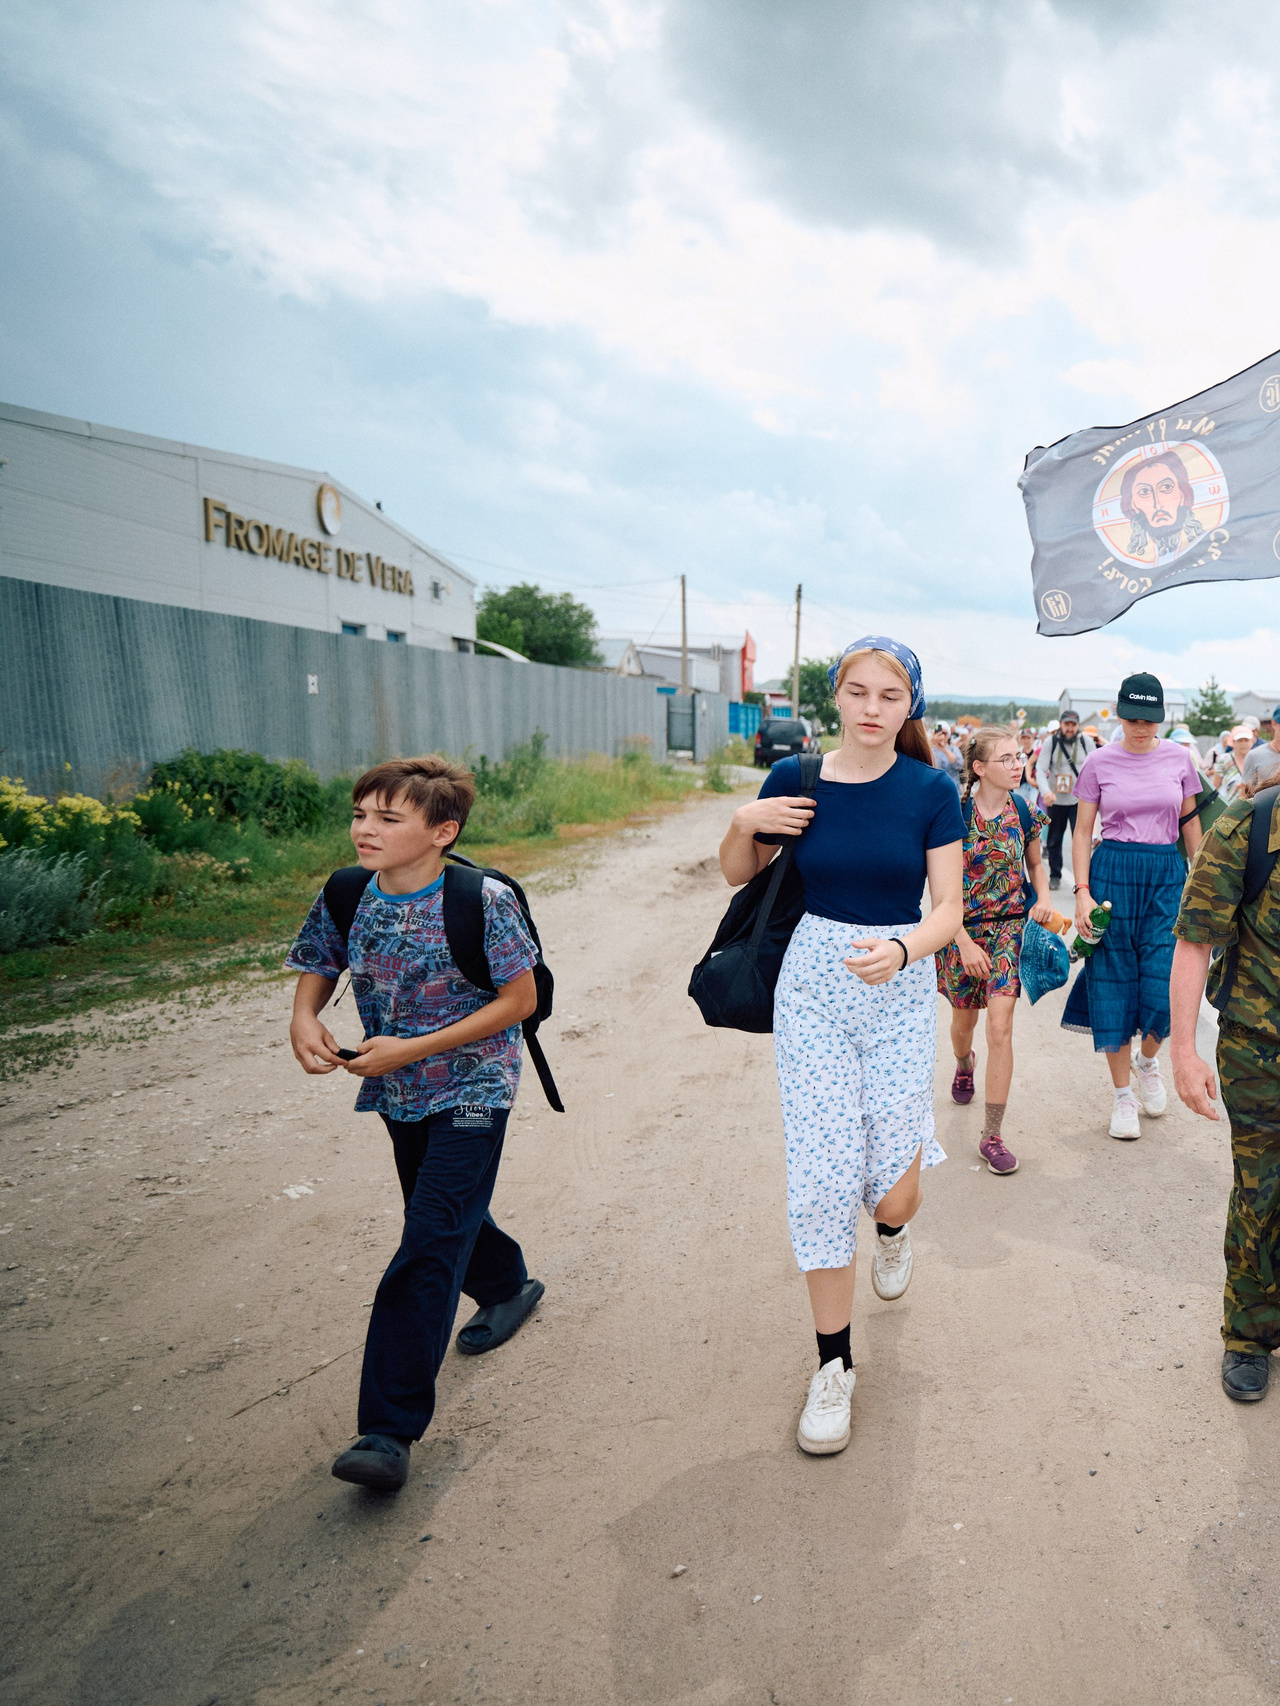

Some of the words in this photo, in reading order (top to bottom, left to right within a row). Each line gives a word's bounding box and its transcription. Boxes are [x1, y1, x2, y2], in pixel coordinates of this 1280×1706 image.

[204, 497, 333, 574] FROMAGE
[337, 547, 364, 583] DE
[366, 552, 414, 597] VERA
